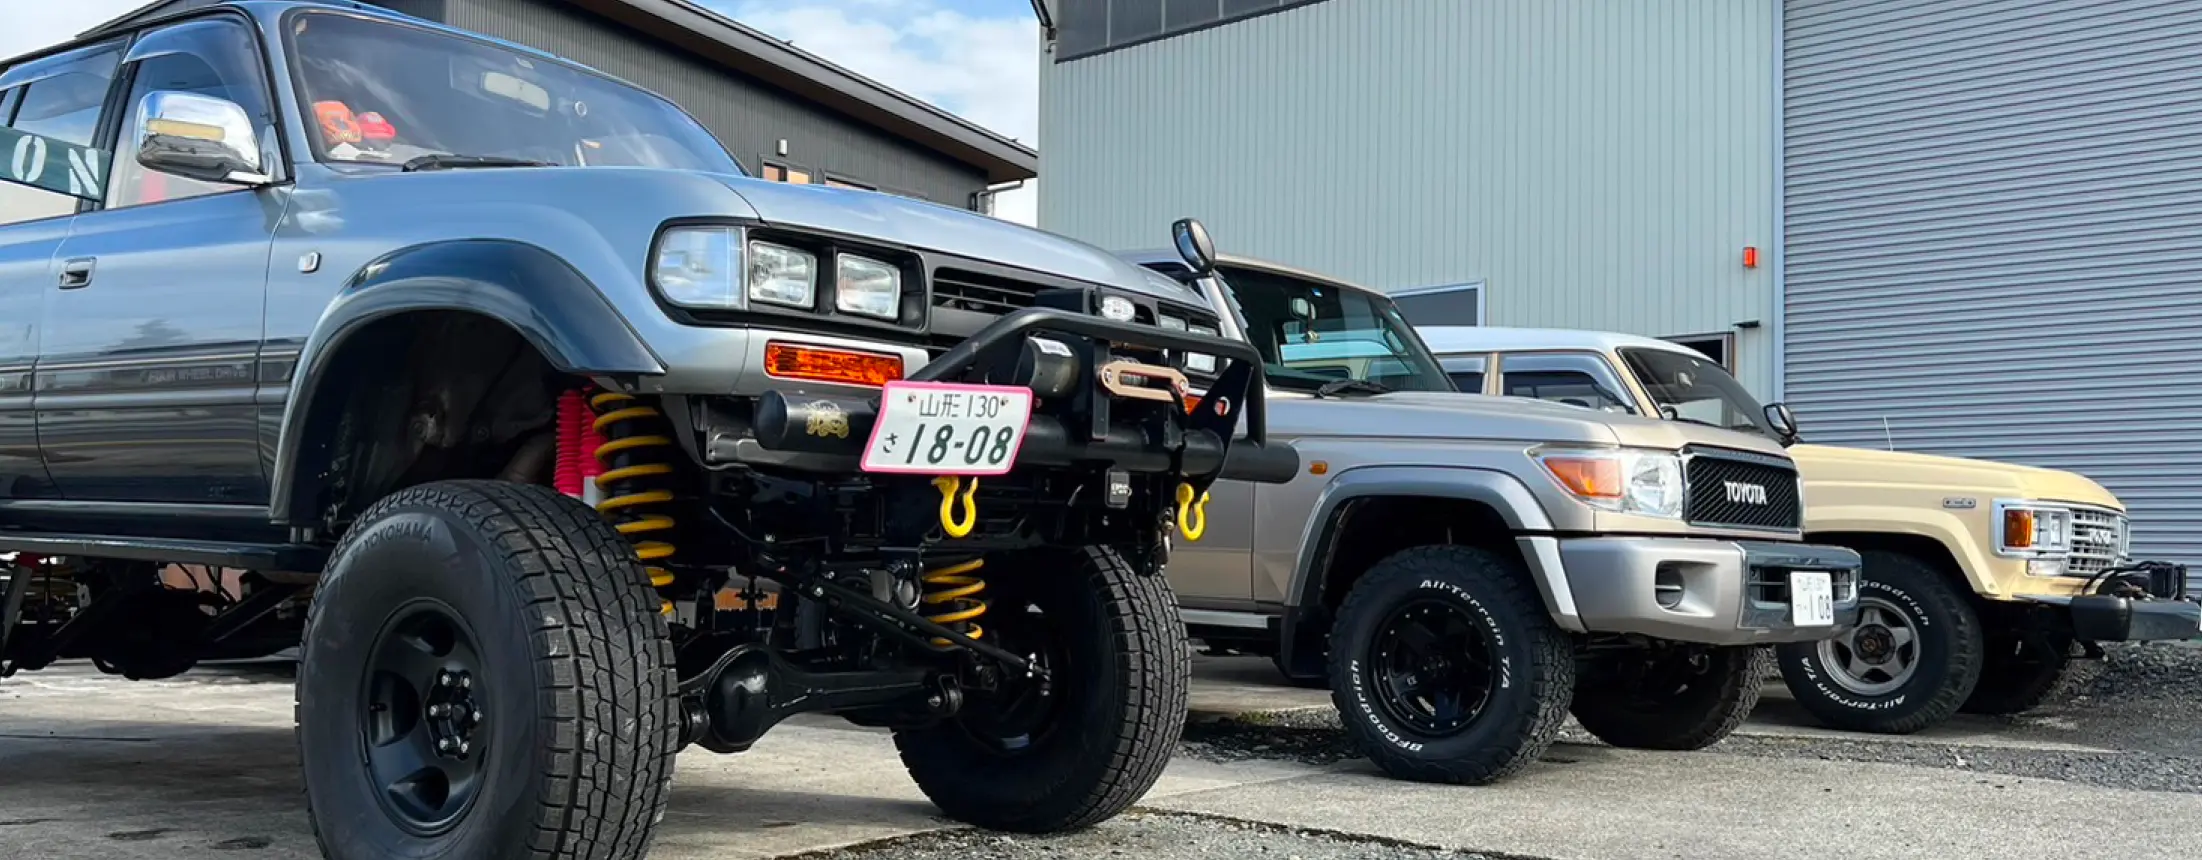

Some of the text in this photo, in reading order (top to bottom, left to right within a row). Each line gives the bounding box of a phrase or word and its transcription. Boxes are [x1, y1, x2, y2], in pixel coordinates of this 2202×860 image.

[919, 393, 999, 418] 山形 130
[883, 423, 1013, 465] さ 18-08
[1724, 480, 1767, 505] TOYOTA
[1420, 580, 1510, 688] All-Terrain T/A
[1351, 660, 1423, 752] BFGoodrich
[1801, 657, 1906, 710] All-Terrain T/A
